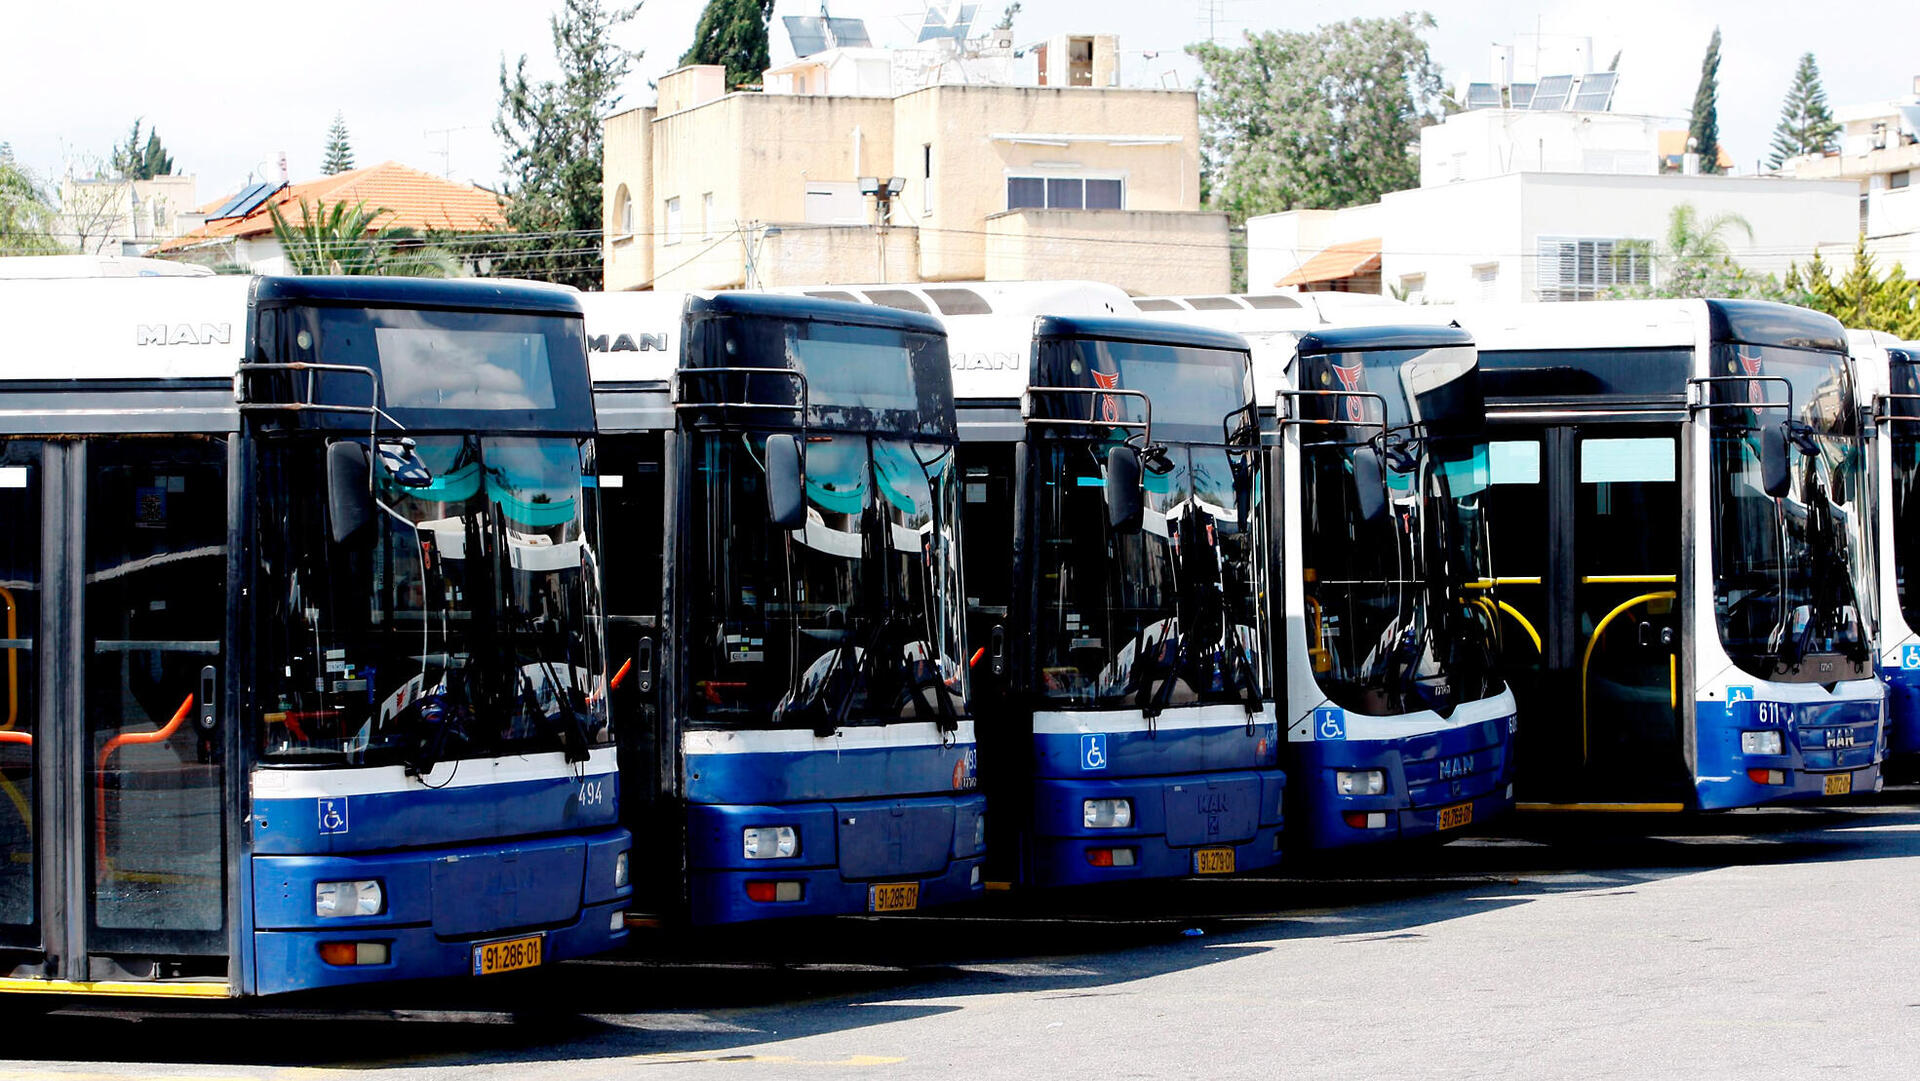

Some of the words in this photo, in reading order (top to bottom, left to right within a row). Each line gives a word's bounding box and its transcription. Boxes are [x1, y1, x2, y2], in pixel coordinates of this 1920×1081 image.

[137, 323, 231, 346] MAN
[587, 333, 668, 352] MAN
[949, 353, 1020, 370] MAN
[1759, 702, 1778, 723] 611
[1826, 728, 1855, 747] MAN
[1439, 755, 1475, 780] MAN
[578, 781, 602, 806] 494
